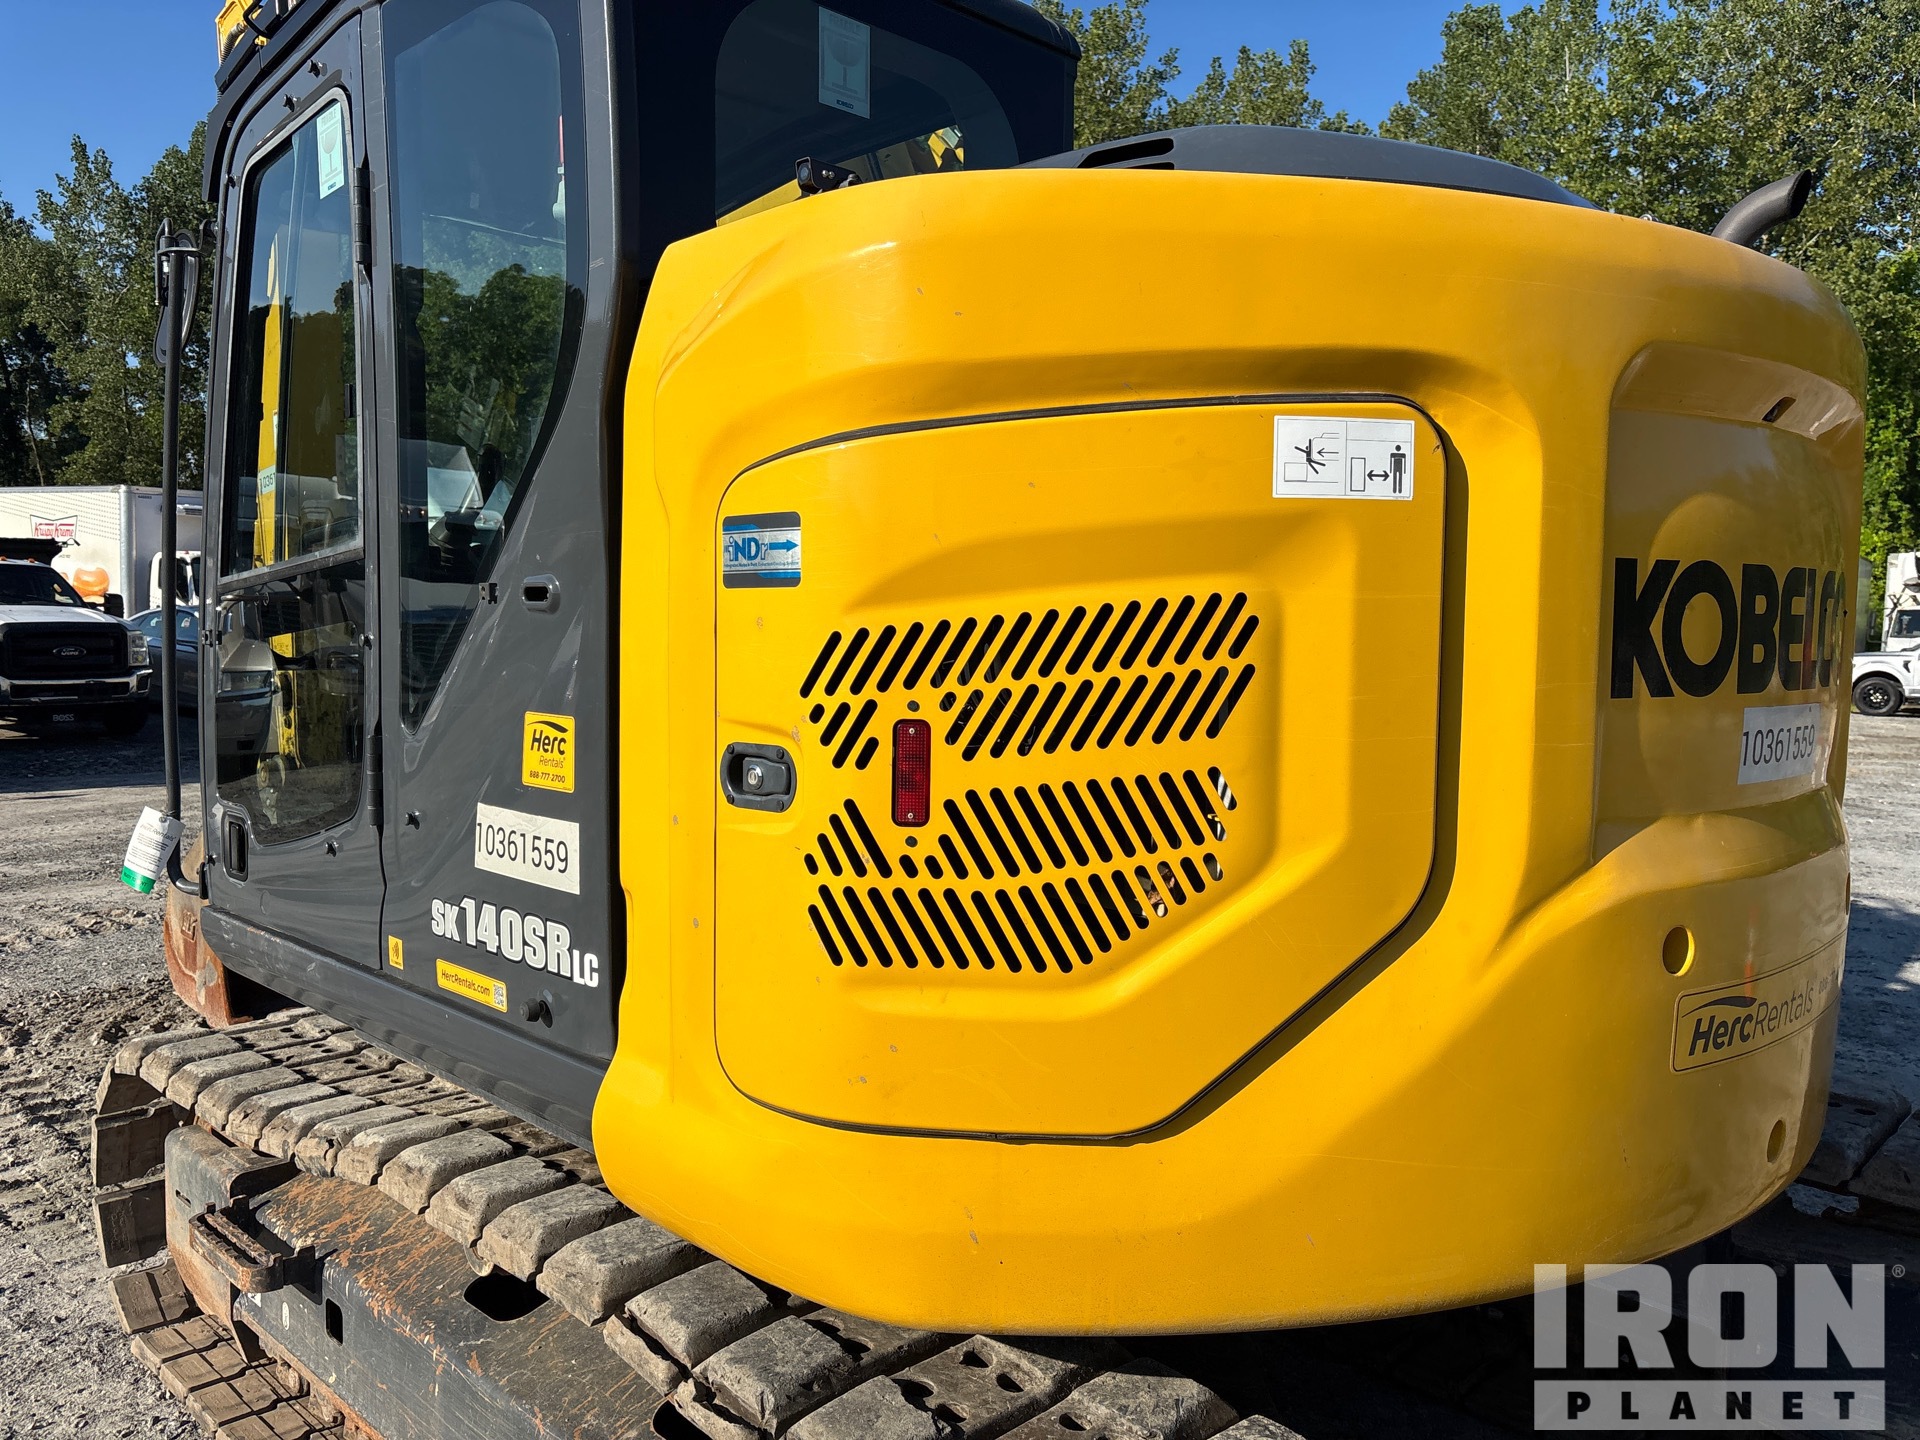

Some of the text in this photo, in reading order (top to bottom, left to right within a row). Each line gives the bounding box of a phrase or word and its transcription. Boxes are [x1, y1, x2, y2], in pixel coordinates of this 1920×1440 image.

[54, 523, 75, 538] Kreme
[53, 714, 75, 722] BOSS
[530, 728, 567, 756] Herc
[1742, 724, 1816, 766] 10361559
[476, 822, 569, 874] 10361559
[441, 968, 490, 997] HercRentals.com
